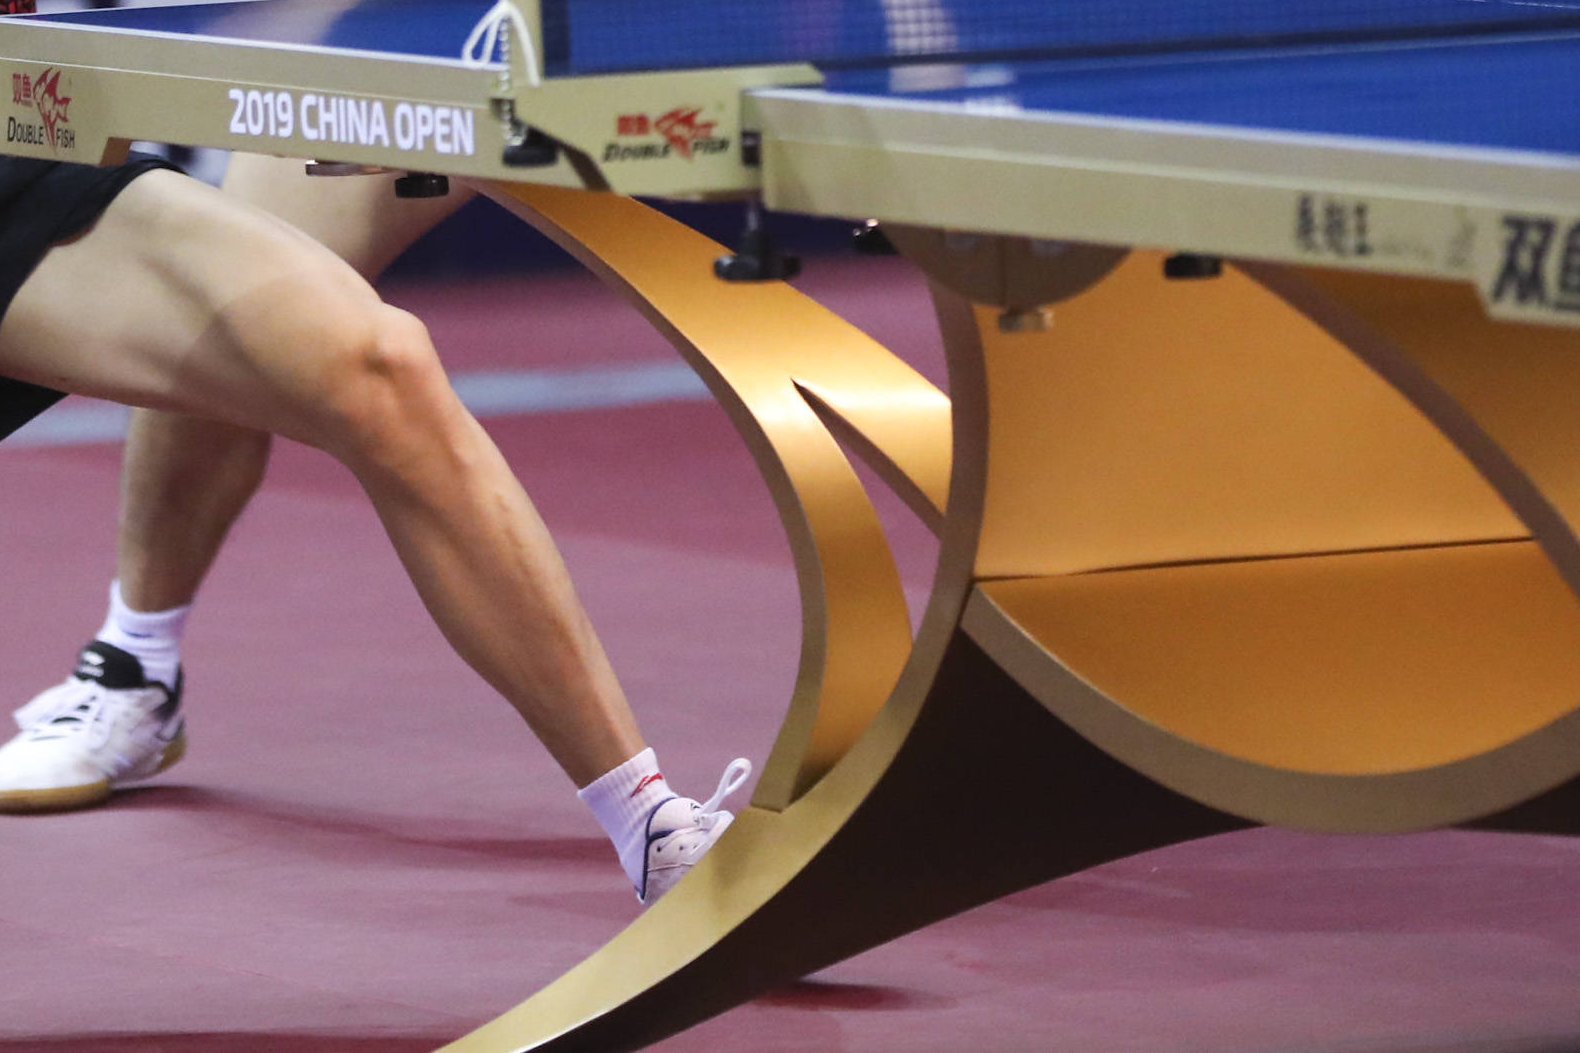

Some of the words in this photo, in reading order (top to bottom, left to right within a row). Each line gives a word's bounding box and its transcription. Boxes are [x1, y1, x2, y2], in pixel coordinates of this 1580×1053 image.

[57, 128, 75, 148] FISH
[228, 88, 294, 137] 2019
[300, 94, 390, 147] CHINA
[394, 102, 476, 155] OPEN
